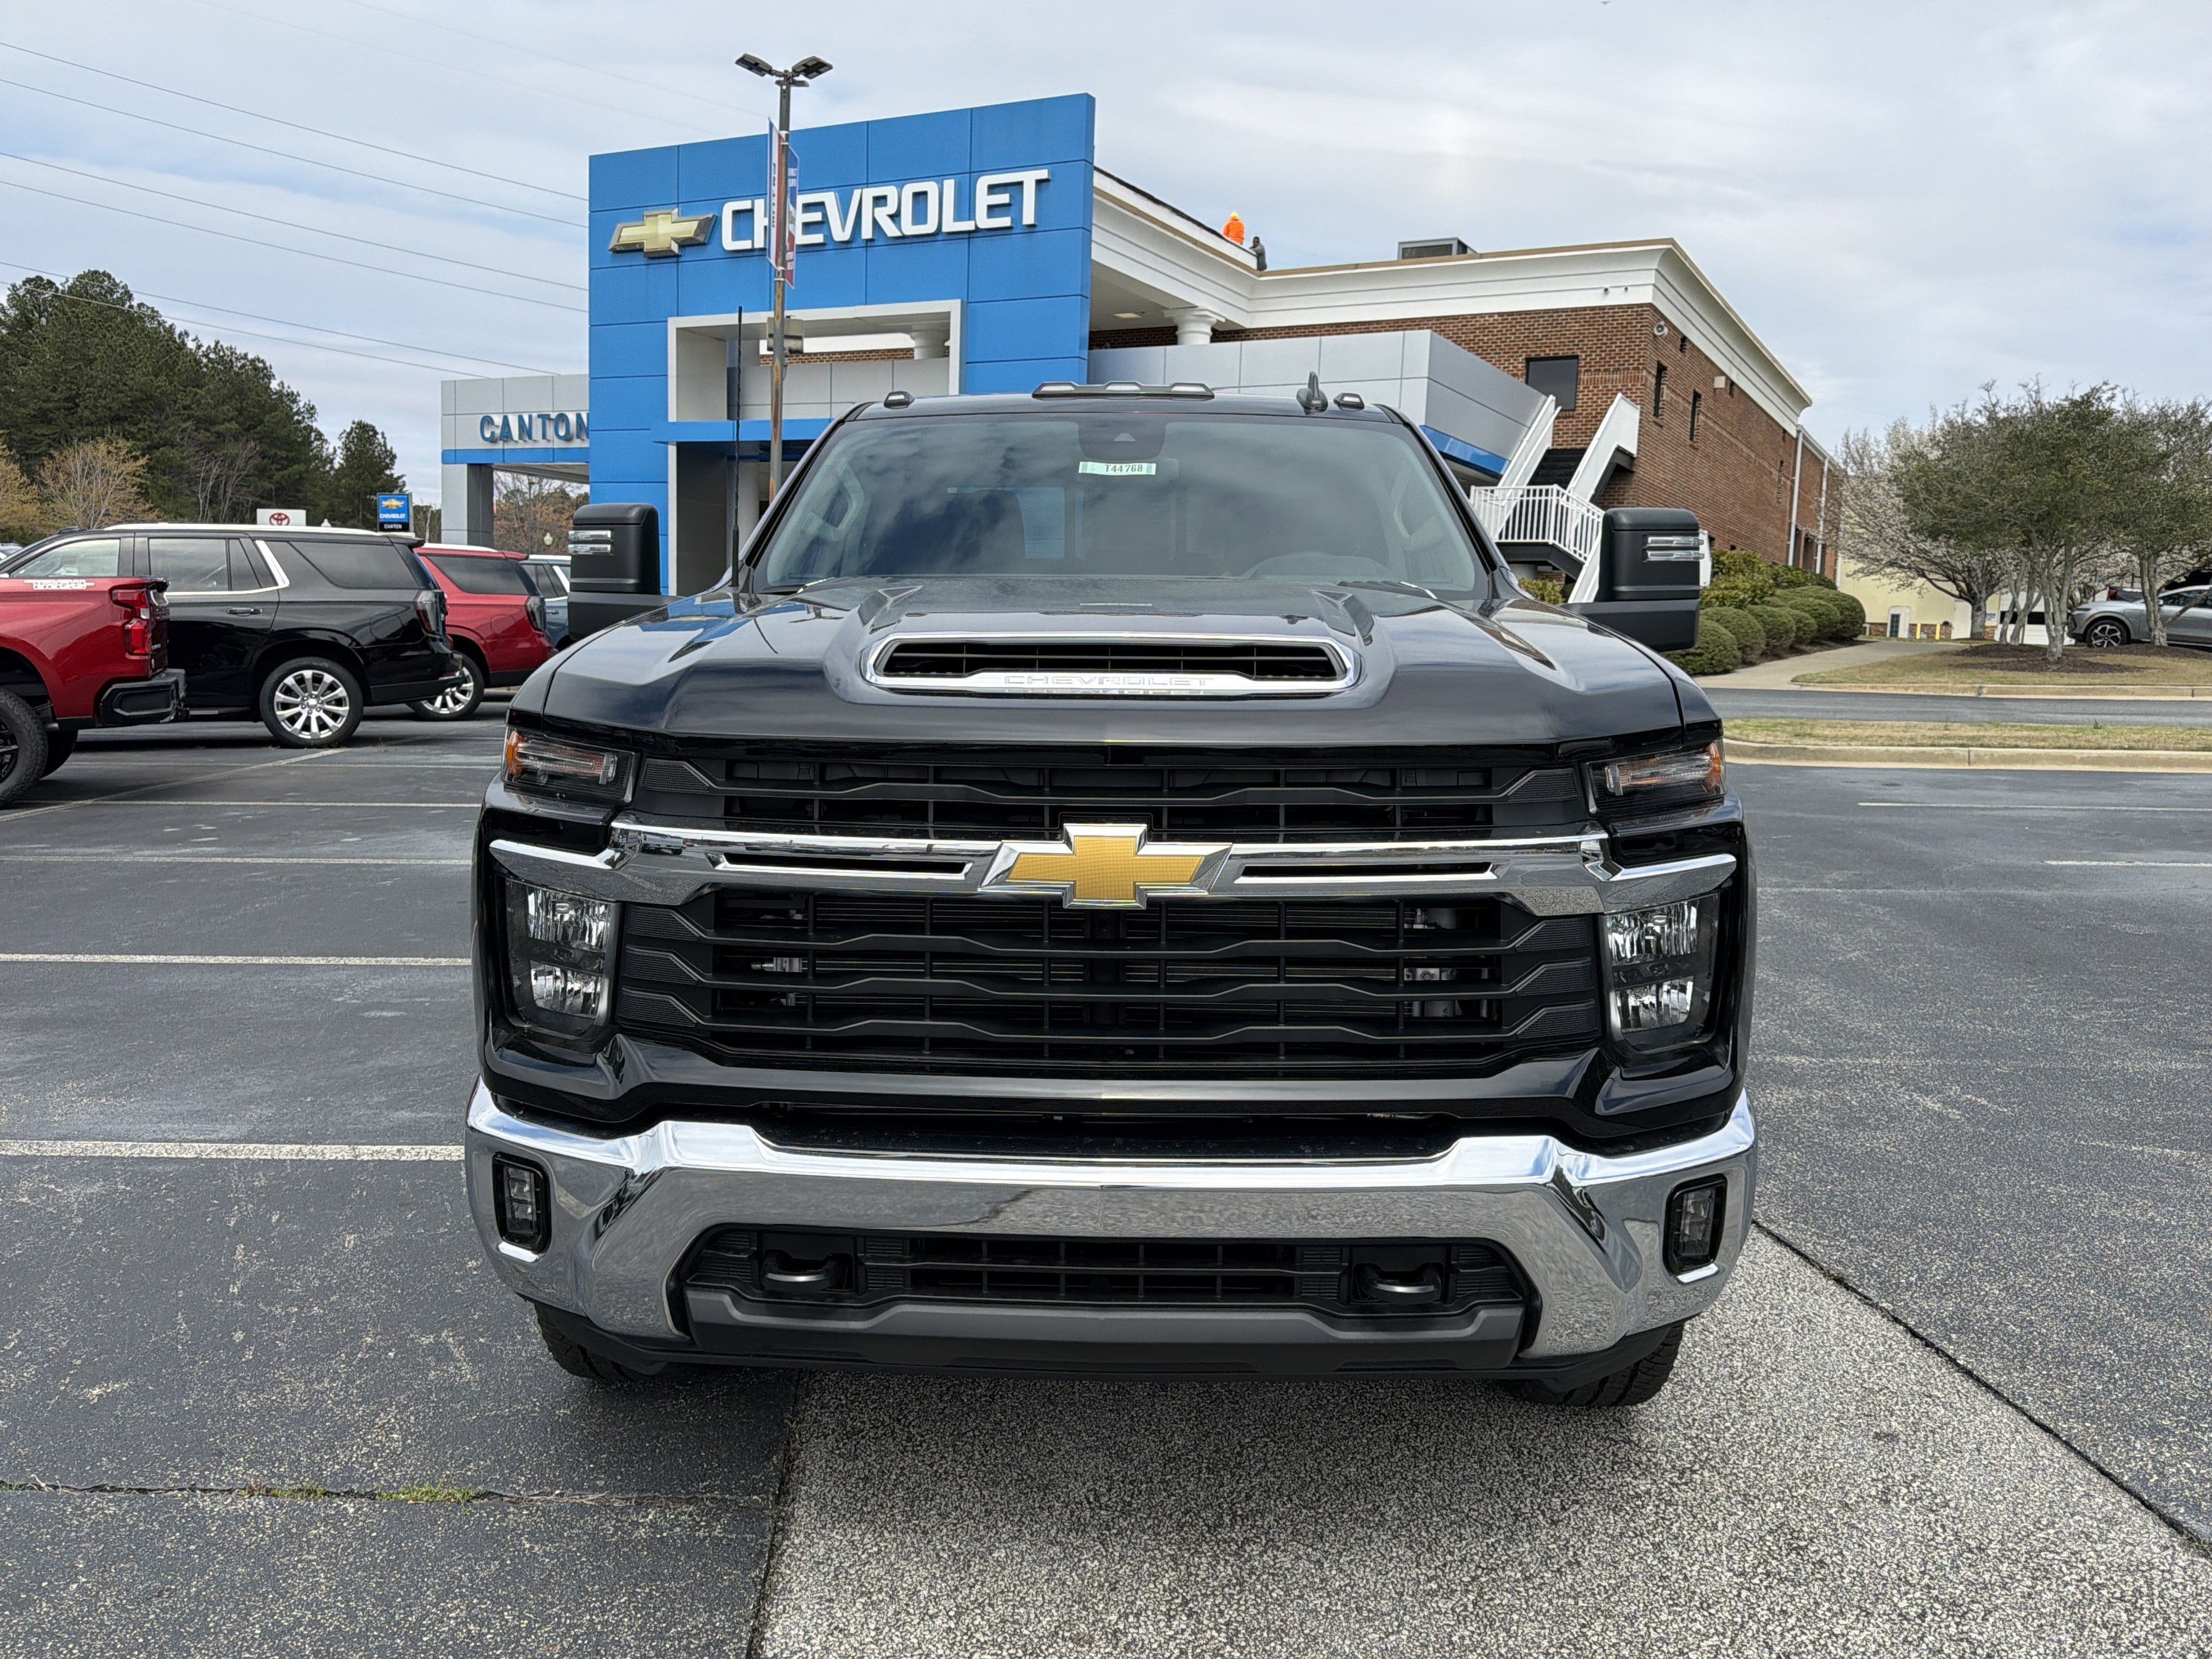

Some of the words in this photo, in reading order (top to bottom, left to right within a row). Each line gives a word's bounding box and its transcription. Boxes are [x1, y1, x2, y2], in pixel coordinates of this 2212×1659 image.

[480, 413, 590, 442] CANTON
[1104, 464, 1143, 473] T44768
[1004, 676, 1214, 686] CHEVROLET
